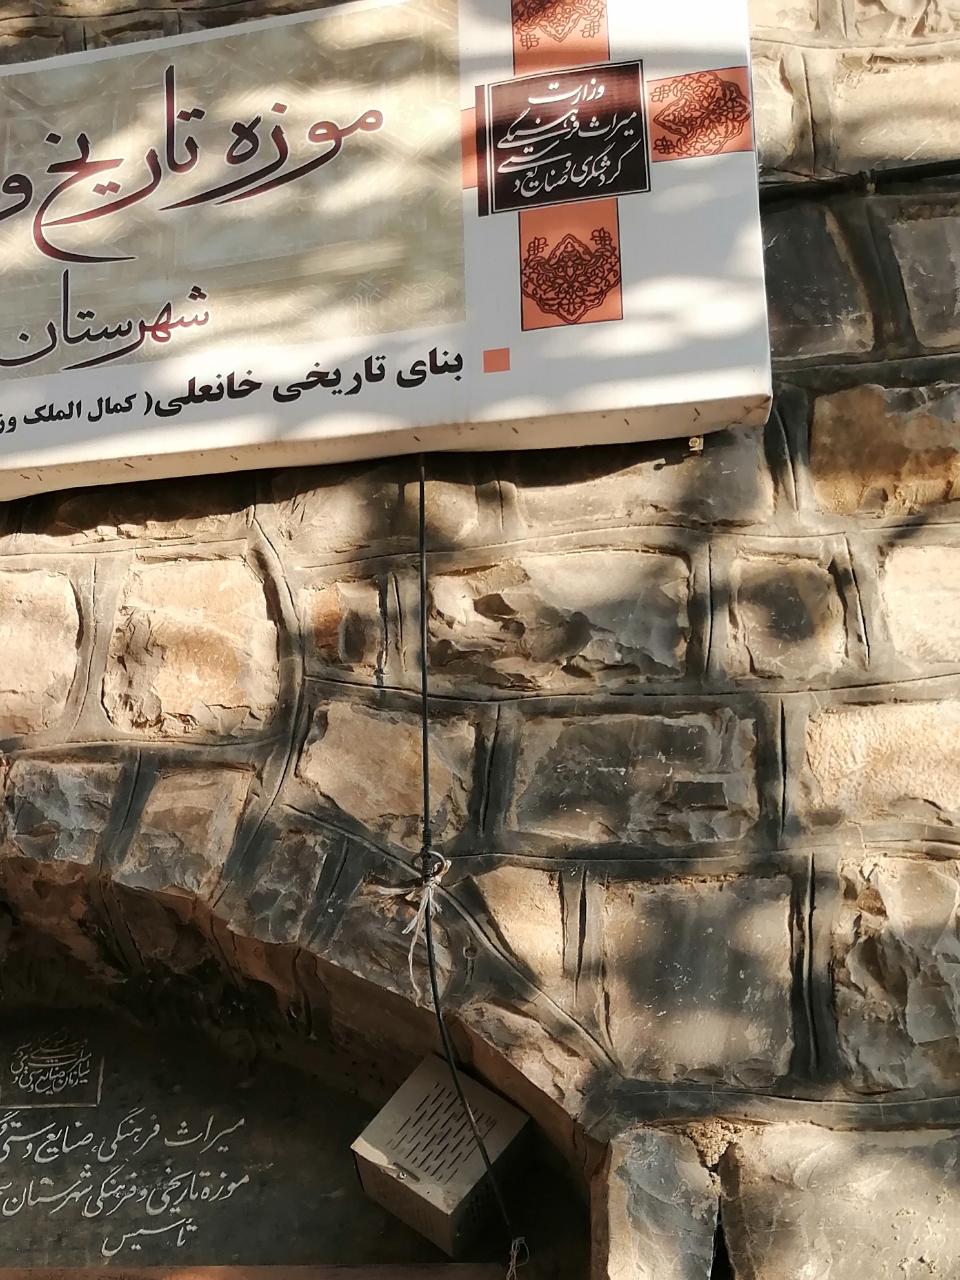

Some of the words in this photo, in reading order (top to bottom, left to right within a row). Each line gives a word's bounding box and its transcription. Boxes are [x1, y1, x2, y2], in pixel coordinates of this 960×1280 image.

[528, 77, 605, 106] وزارت
[497, 107, 581, 149] فرهنگی
[577, 112, 637, 141] میراث
[31, 64, 206, 263] تاریخ
[158, 100, 386, 212] موزه
[571, 138, 642, 188] گردشگری
[520, 165, 569, 198] صنایع
[272, 354, 387, 403] تاریخی
[396, 346, 464, 389] بنای
[23, 399, 82, 425] الملک
[87, 393, 137, 422] کمال
[33, 1121, 95, 1163] صنایع
[164, 1115, 245, 1154] میراث
[2, 1164, 93, 1217] شهرستان
[83, 1163, 139, 1218] فرهنگی
[145, 1167, 211, 1216] تاریخی
[201, 1171, 251, 1203] موزه
